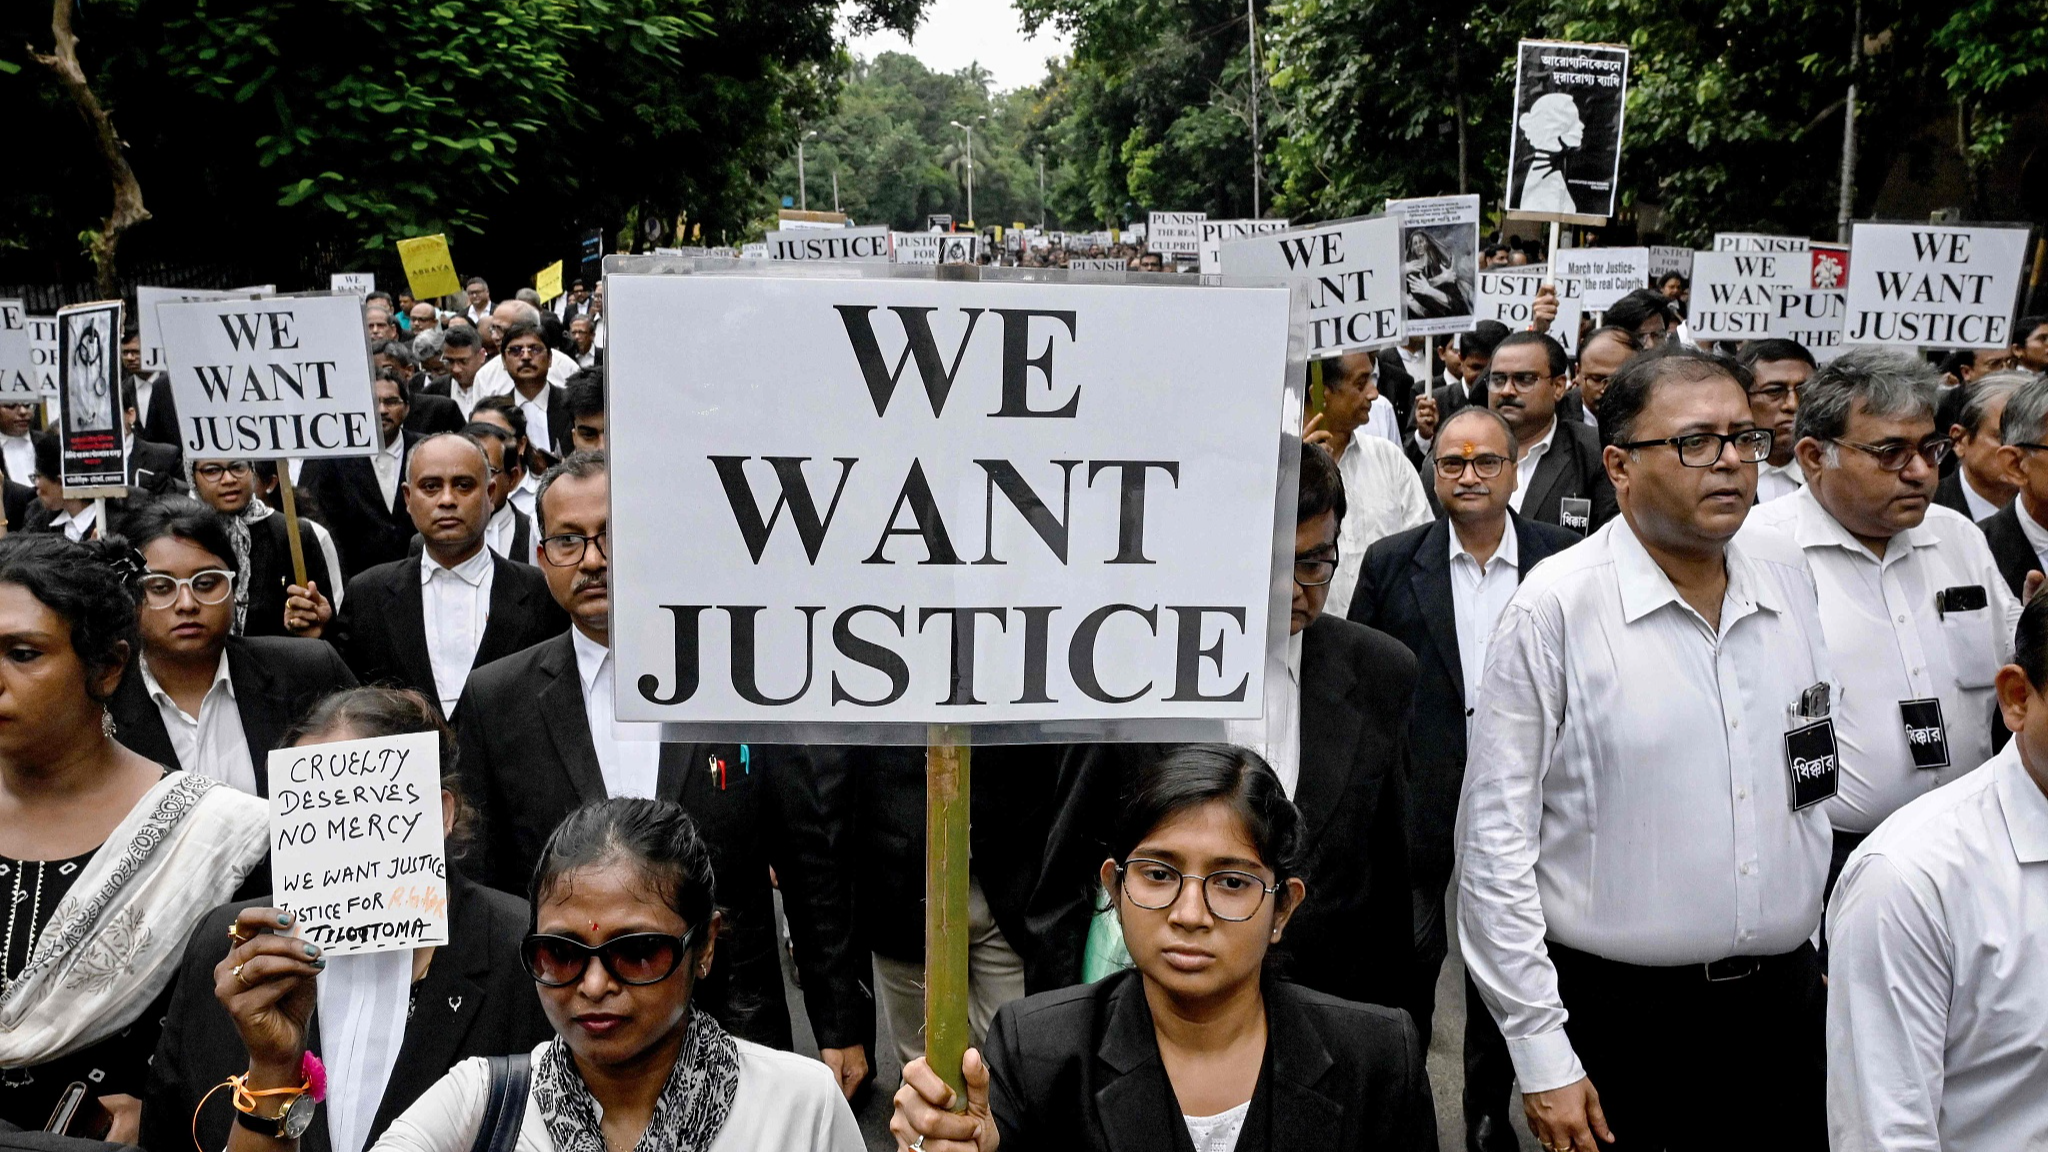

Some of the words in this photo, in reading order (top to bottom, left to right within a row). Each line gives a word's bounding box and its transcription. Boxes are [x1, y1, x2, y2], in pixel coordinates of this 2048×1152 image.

[1152, 214, 1204, 224] PUNISH
[1157, 229, 1175, 237] THE
[1177, 229, 1196, 237] REA
[773, 236, 888, 261] JUSTICE
[913, 251, 935, 259] FOR
[1278, 232, 1344, 271] WE
[1720, 237, 1804, 252] PUNISH
[1911, 232, 1971, 265] WE
[1072, 261, 1125, 271] PUNISH
[1568, 261, 1591, 275] March
[1593, 261, 1604, 274] for
[1734, 256, 1777, 279] WE
[1310, 270, 1373, 310] NT
[1585, 278, 1597, 291] the
[1599, 278, 1613, 291] real
[1615, 277, 1644, 292] Culprits
[1875, 271, 1993, 305] WANT
[218, 311, 299, 352] WE
[1309, 308, 1397, 350] TICE
[1692, 311, 1769, 333] JUSTI
[1850, 311, 2006, 344] JUSTICE
[1789, 330, 1841, 348] THE
[833, 304, 1082, 419] WE
[193, 361, 336, 403] WANT
[189, 412, 371, 452] JUSTICE
[706, 455, 1180, 566] WANT
[1562, 511, 1588, 528] ধিক্কার
[637, 603, 1250, 707] JUSTICE
[1904, 723, 1942, 746] ধিক্কার
[290, 748, 410, 783] CRUELTY
[1793, 754, 1835, 784] ধিক্কার
[278, 783, 420, 816] DESERVES
[278, 822, 317, 850] NO
[328, 812, 422, 843] MERCY
[284, 873, 314, 892] WE
[323, 861, 381, 887] WANT
[386, 854, 446, 880] JUSTICE
[280, 903, 342, 923] JUSTICE
[347, 892, 384, 913] FOR
